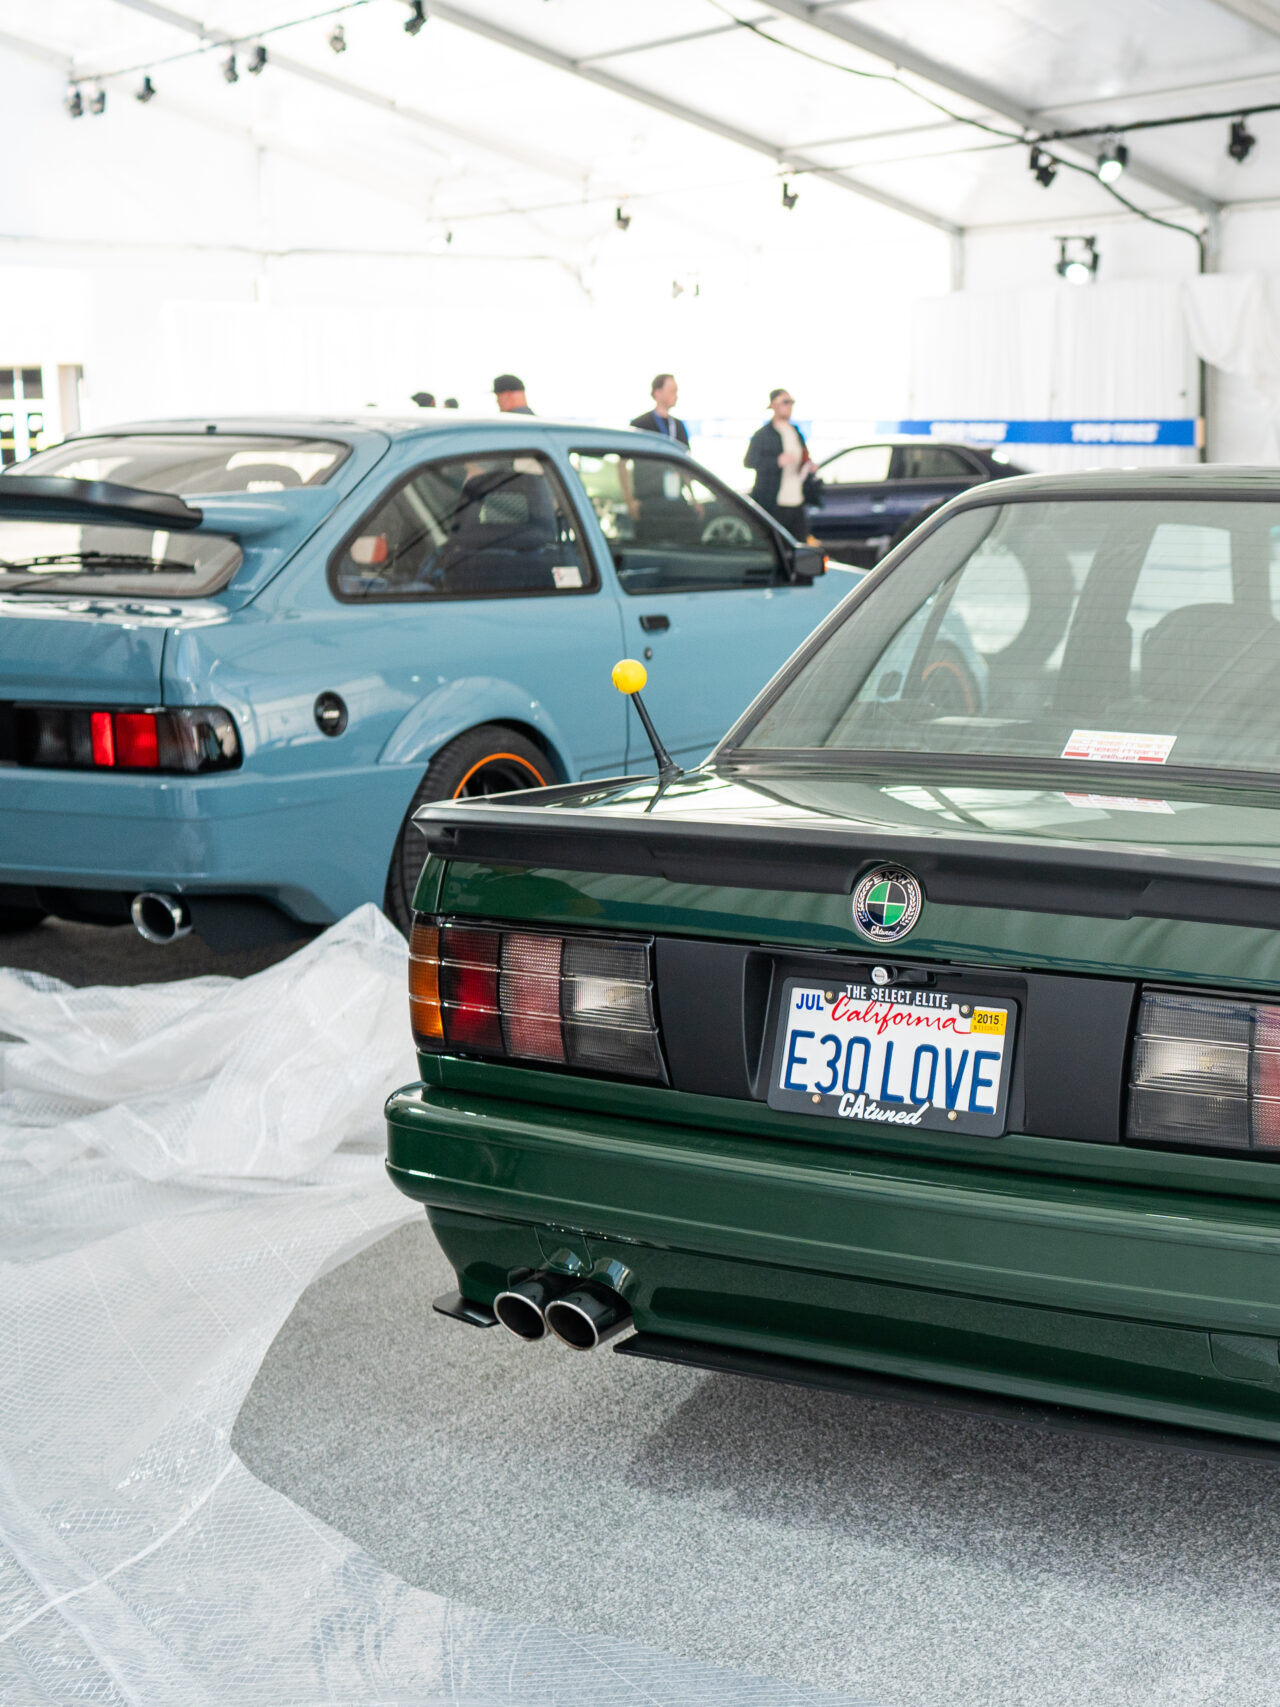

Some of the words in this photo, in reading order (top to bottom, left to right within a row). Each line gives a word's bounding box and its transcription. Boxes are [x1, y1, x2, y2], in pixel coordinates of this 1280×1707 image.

[796, 993, 824, 1011] JUL
[846, 984, 867, 1000] THE
[871, 988, 912, 1004] SELECT
[915, 992, 949, 1008] ELITE
[831, 995, 972, 1035] California
[977, 1013, 1000, 1025] 2015
[838, 1093, 930, 1125] CAtuned
